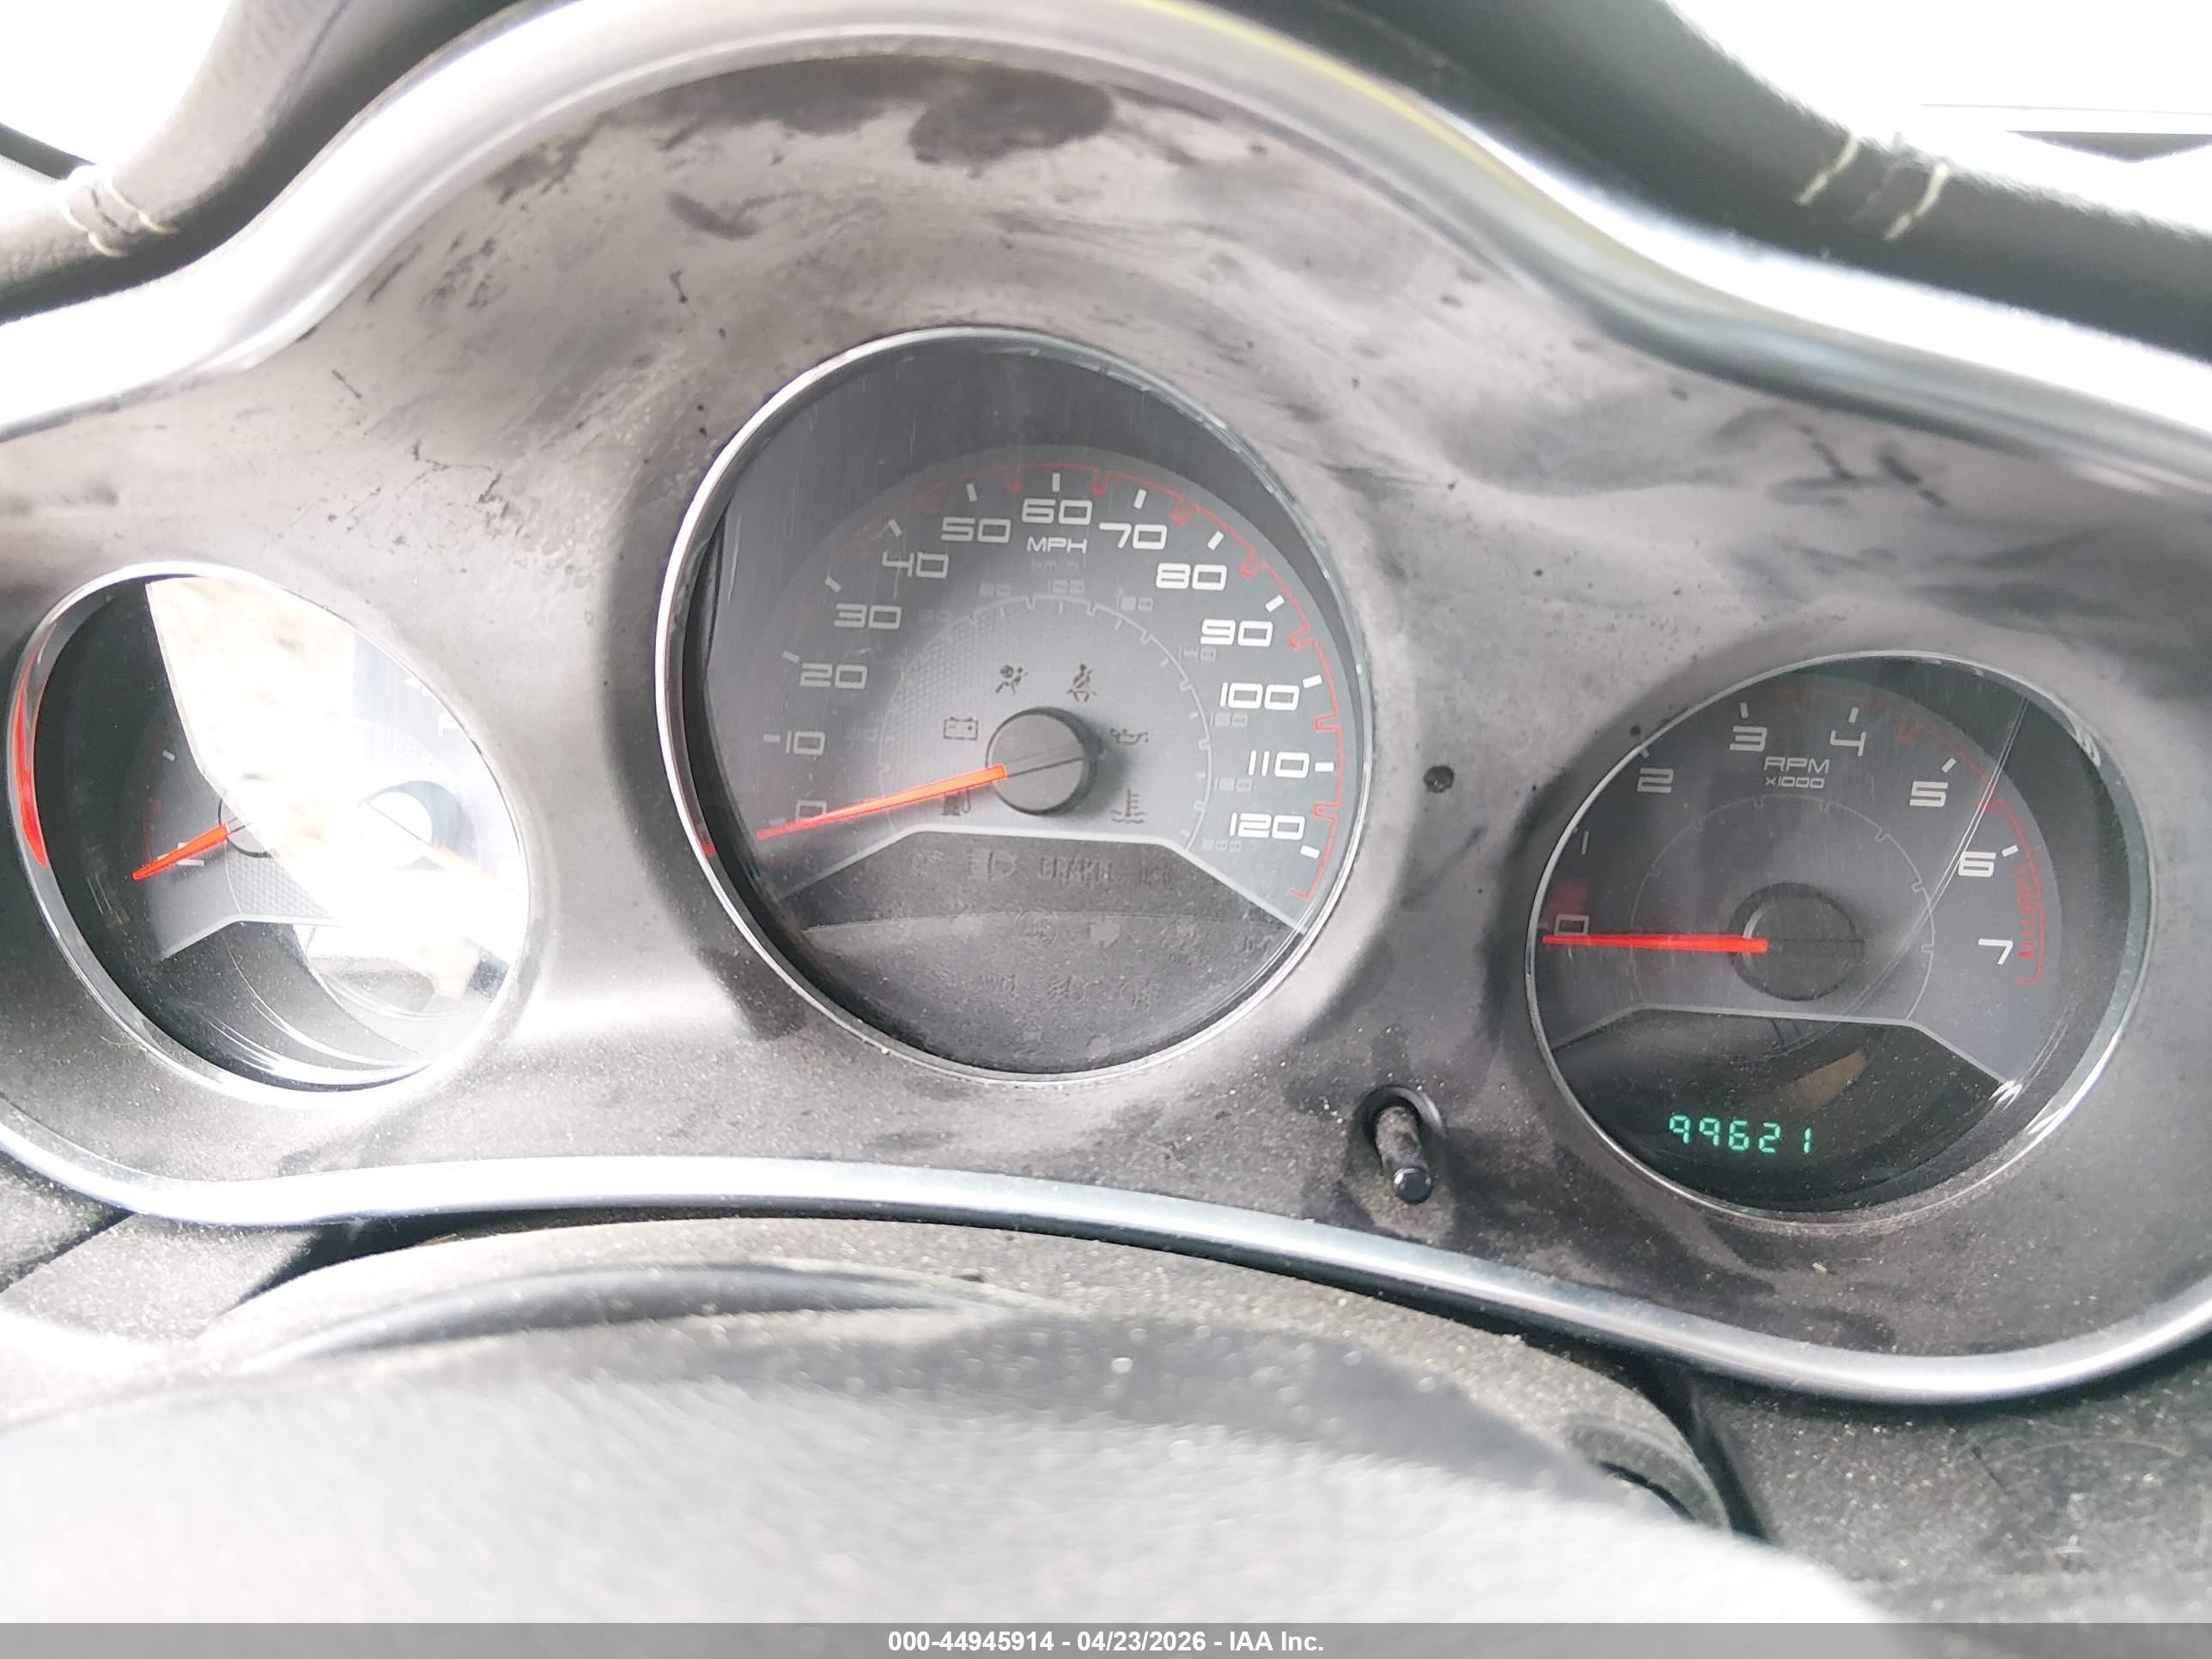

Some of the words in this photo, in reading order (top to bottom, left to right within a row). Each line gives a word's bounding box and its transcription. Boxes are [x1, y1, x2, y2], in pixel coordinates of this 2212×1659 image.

[1022, 498, 1092, 526] 60
[941, 516, 1012, 544] 50
[1099, 522, 1167, 550] 70
[1027, 537, 1087, 554] MPH
[882, 551, 950, 579] 40
[1156, 562, 1227, 591] 80
[834, 604, 902, 630] 30
[1200, 618, 1273, 647] 90
[799, 662, 868, 690] 20
[1219, 682, 1300, 711] 100
[785, 730, 826, 756] 10
[1729, 726, 1767, 752] 3
[1830, 730, 1866, 757] 4
[1248, 750, 1310, 778] 110
[1763, 756, 1830, 774] RPM
[1637, 768, 1674, 793] 2
[1909, 781, 1948, 807] 5
[1229, 811, 1306, 840] 120
[1581, 830, 1589, 855] 1
[1958, 851, 1996, 878] 6
[1554, 914, 1589, 936] 0
[1978, 939, 2014, 965] 7
[1669, 1115, 1811, 1154] 99621
